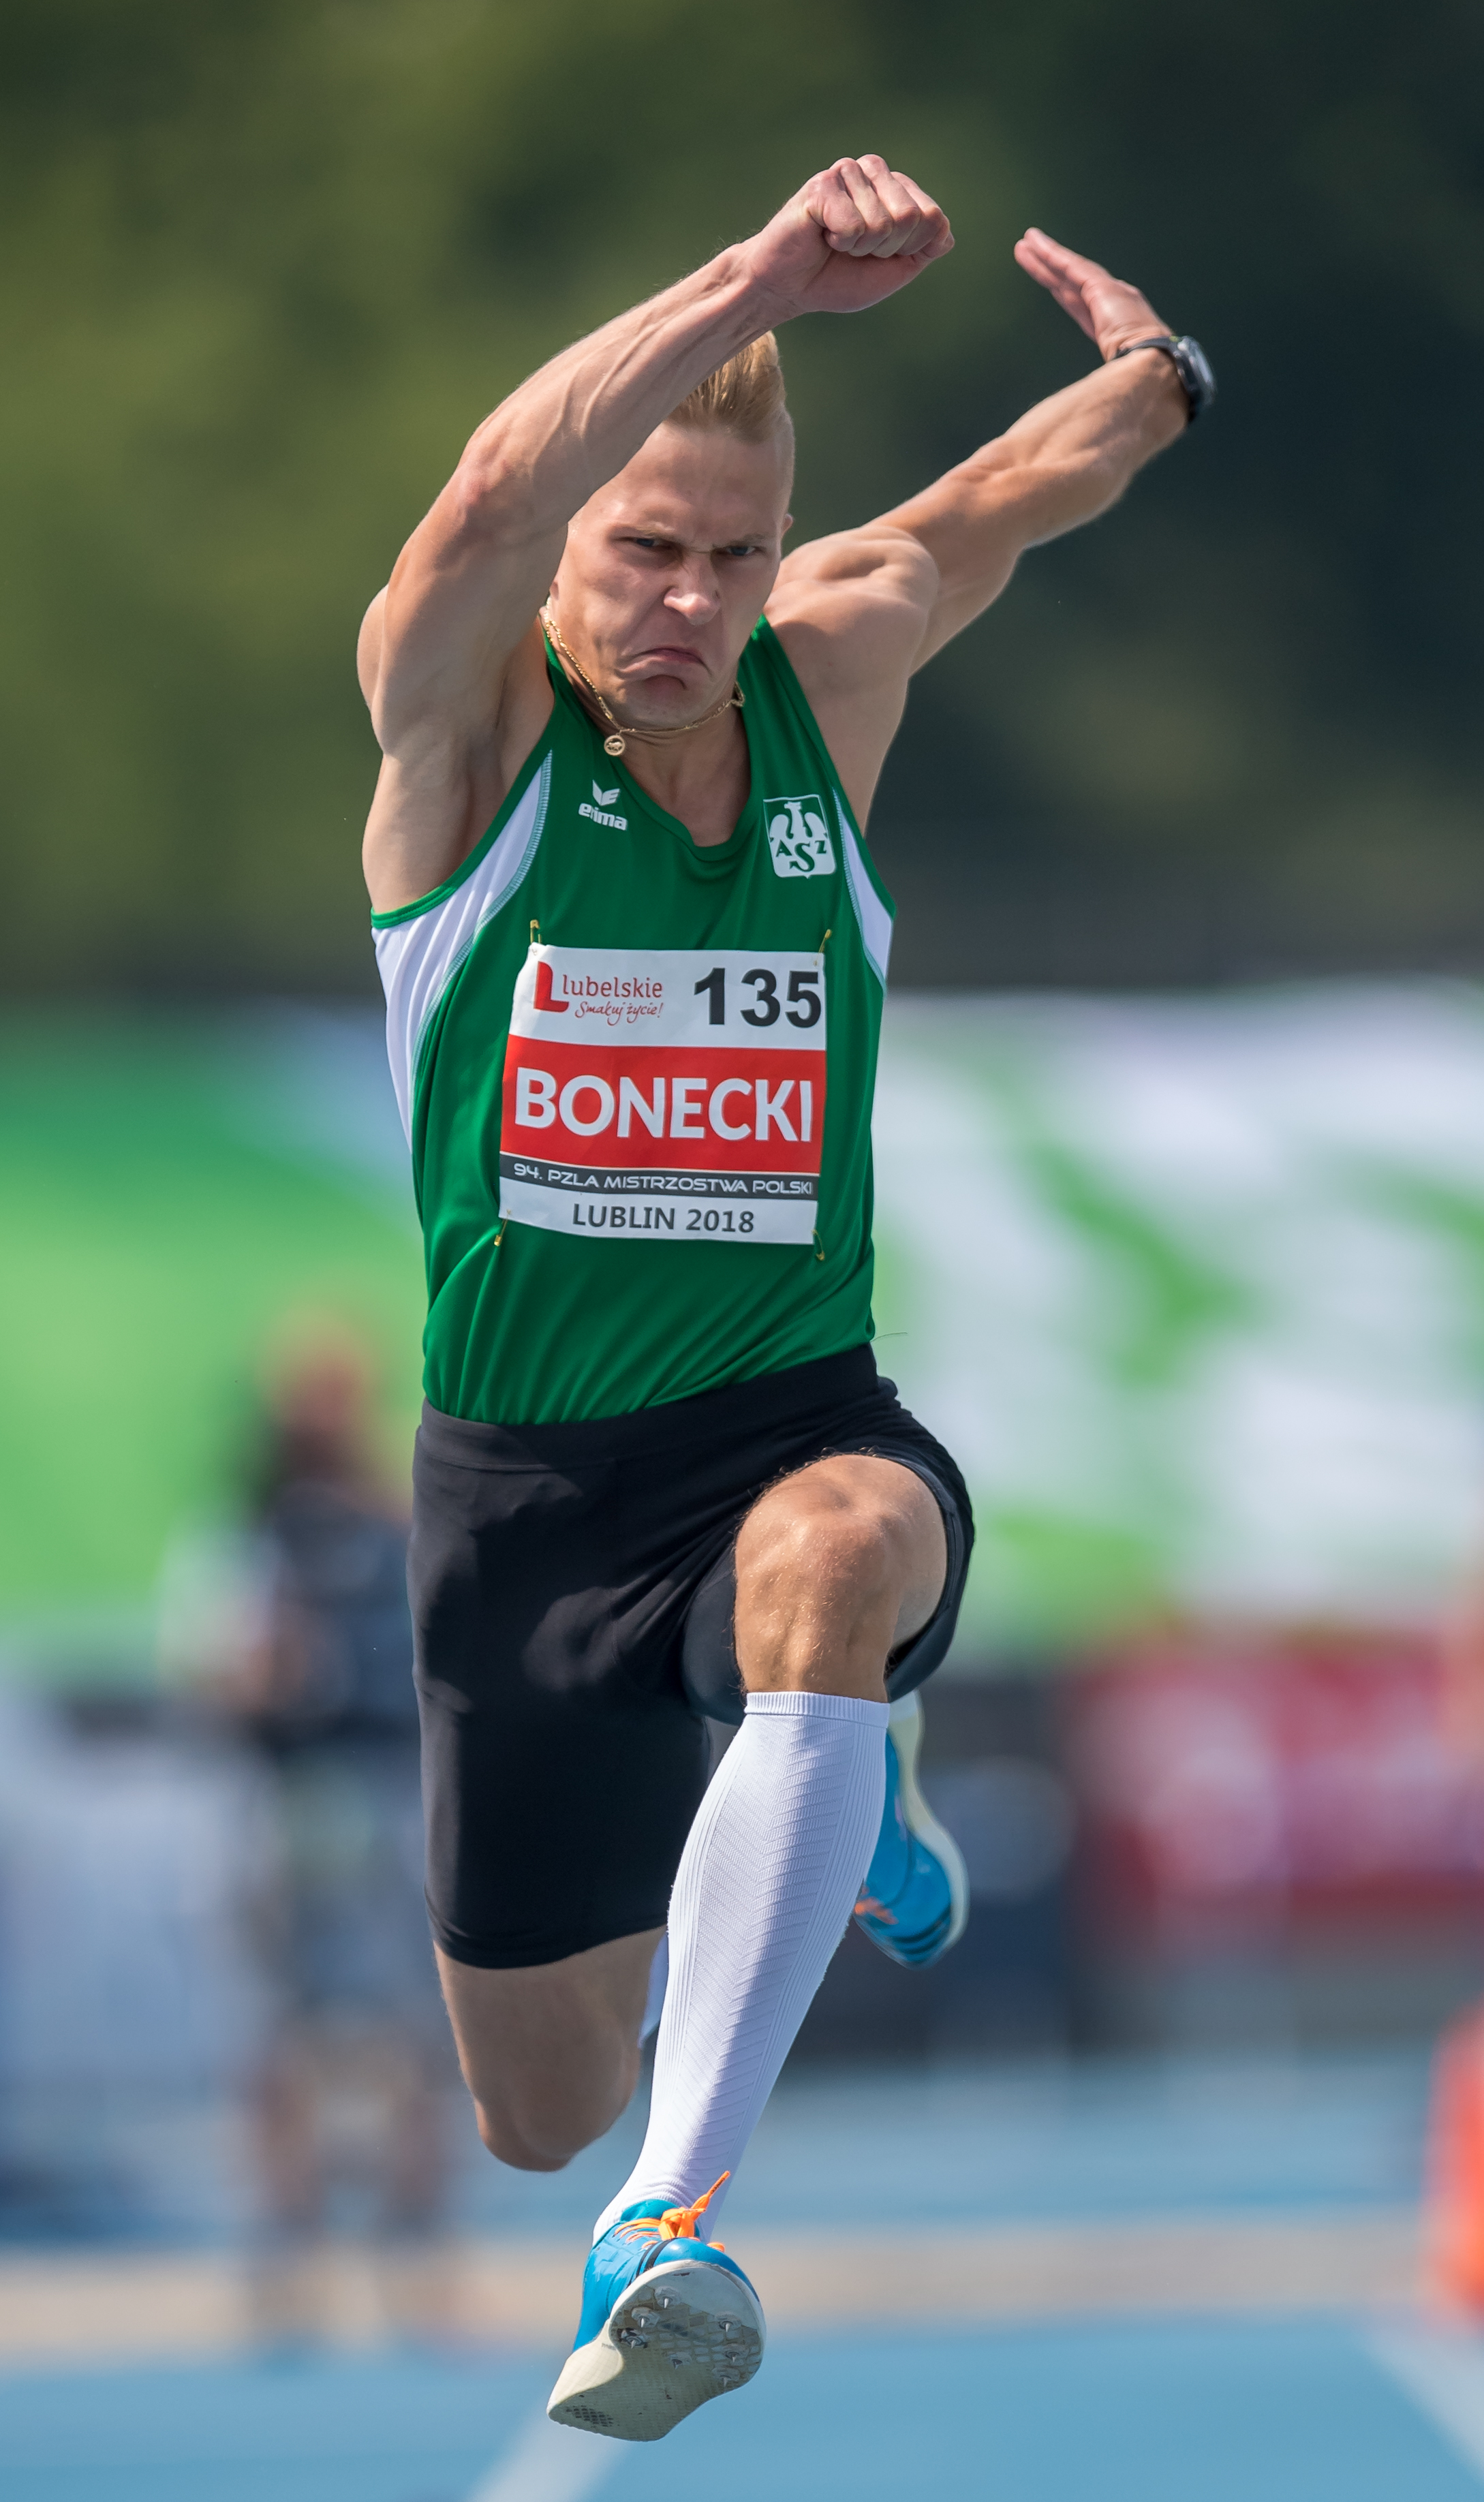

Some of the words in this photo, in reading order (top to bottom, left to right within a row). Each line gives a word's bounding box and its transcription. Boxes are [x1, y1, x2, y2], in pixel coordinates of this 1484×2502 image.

[775, 839, 827, 872] ASZ
[574, 1001, 625, 1026] Smakuj
[626, 1002, 664, 1023] życie!
[694, 967, 822, 1028] 135
[514, 1066, 813, 1143] BONECKI
[514, 1162, 543, 1180] 94.
[548, 1169, 600, 1188] PZLA
[604, 1175, 749, 1193] MISTRZOSTWA
[752, 1179, 814, 1194] POLSKI
[572, 1203, 675, 1230] LUBLIN
[685, 1209, 754, 1233] 2018
